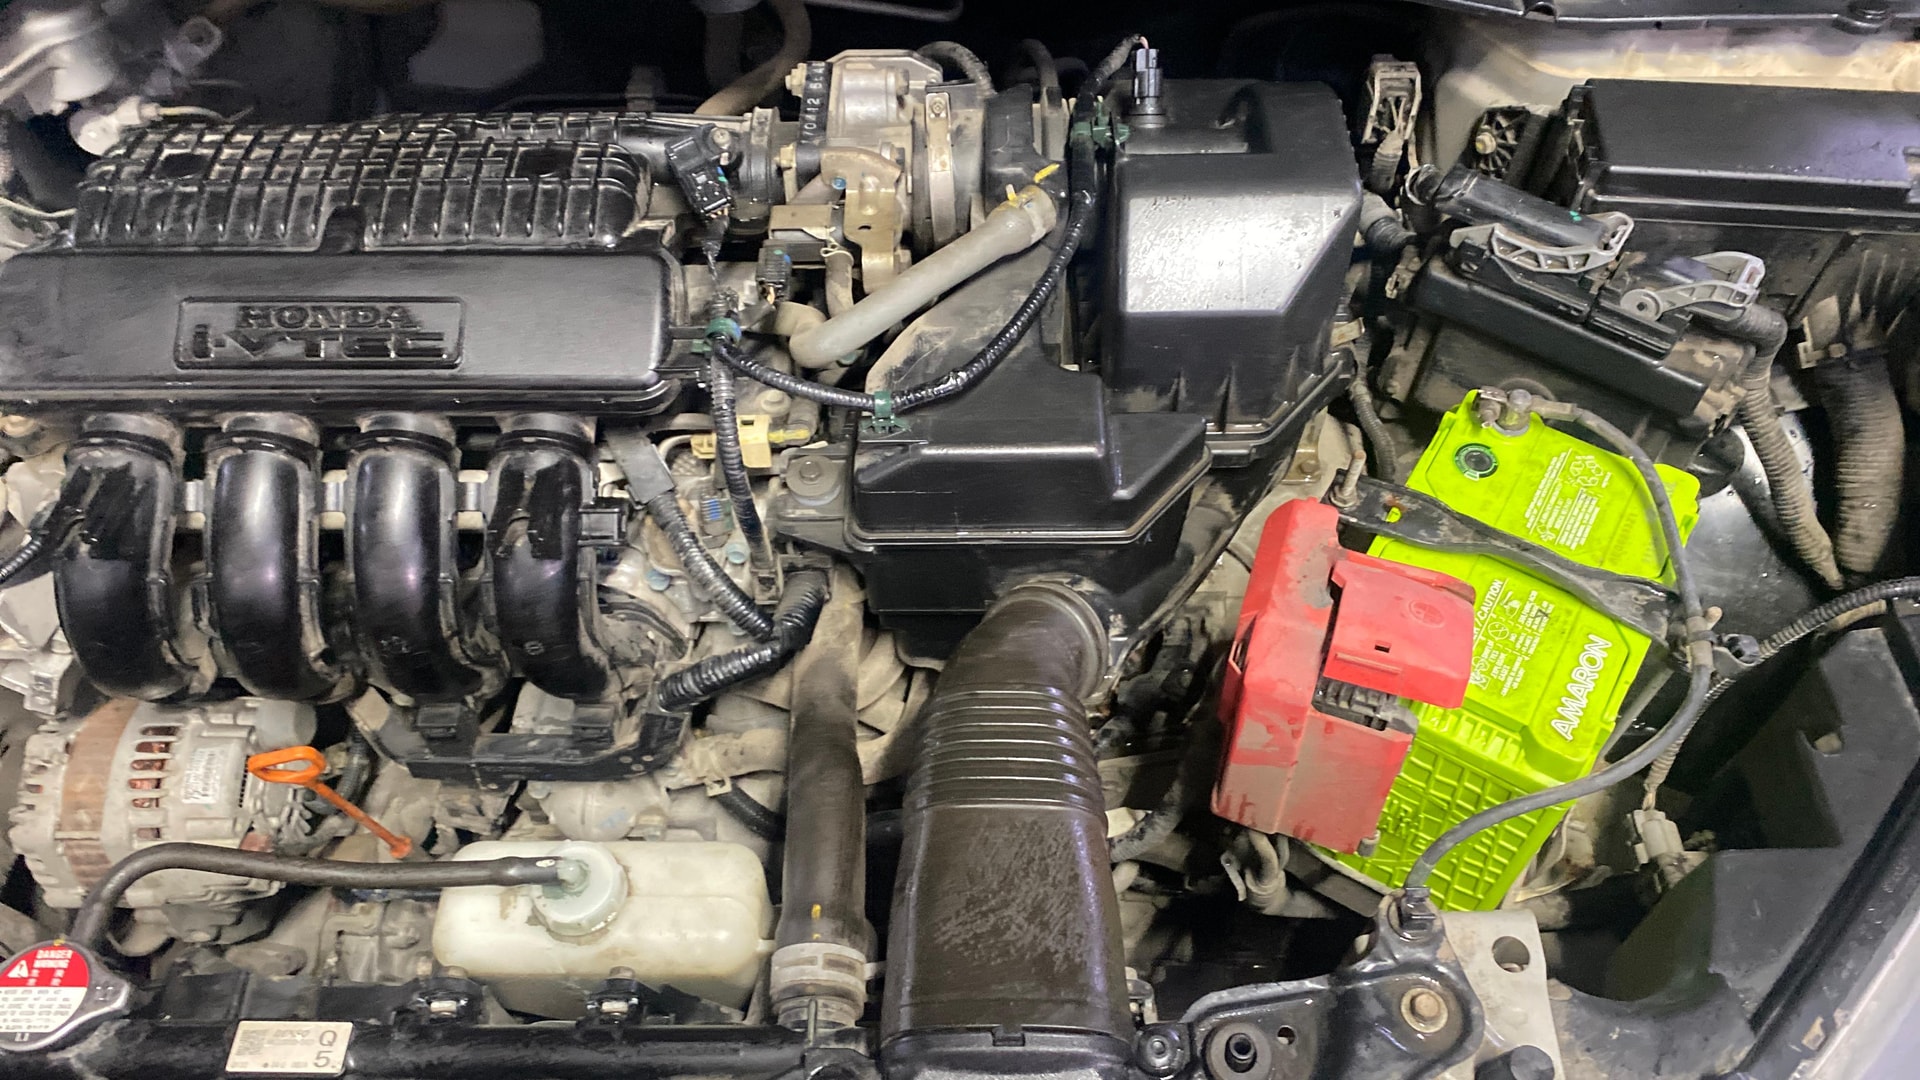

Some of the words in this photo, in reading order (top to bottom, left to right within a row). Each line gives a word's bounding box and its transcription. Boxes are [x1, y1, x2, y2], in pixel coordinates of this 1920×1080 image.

[236, 305, 423, 329] HONDA
[192, 324, 445, 359] i-VTEC
[1551, 634, 1612, 740] AMARON
[319, 1030, 338, 1047] Q
